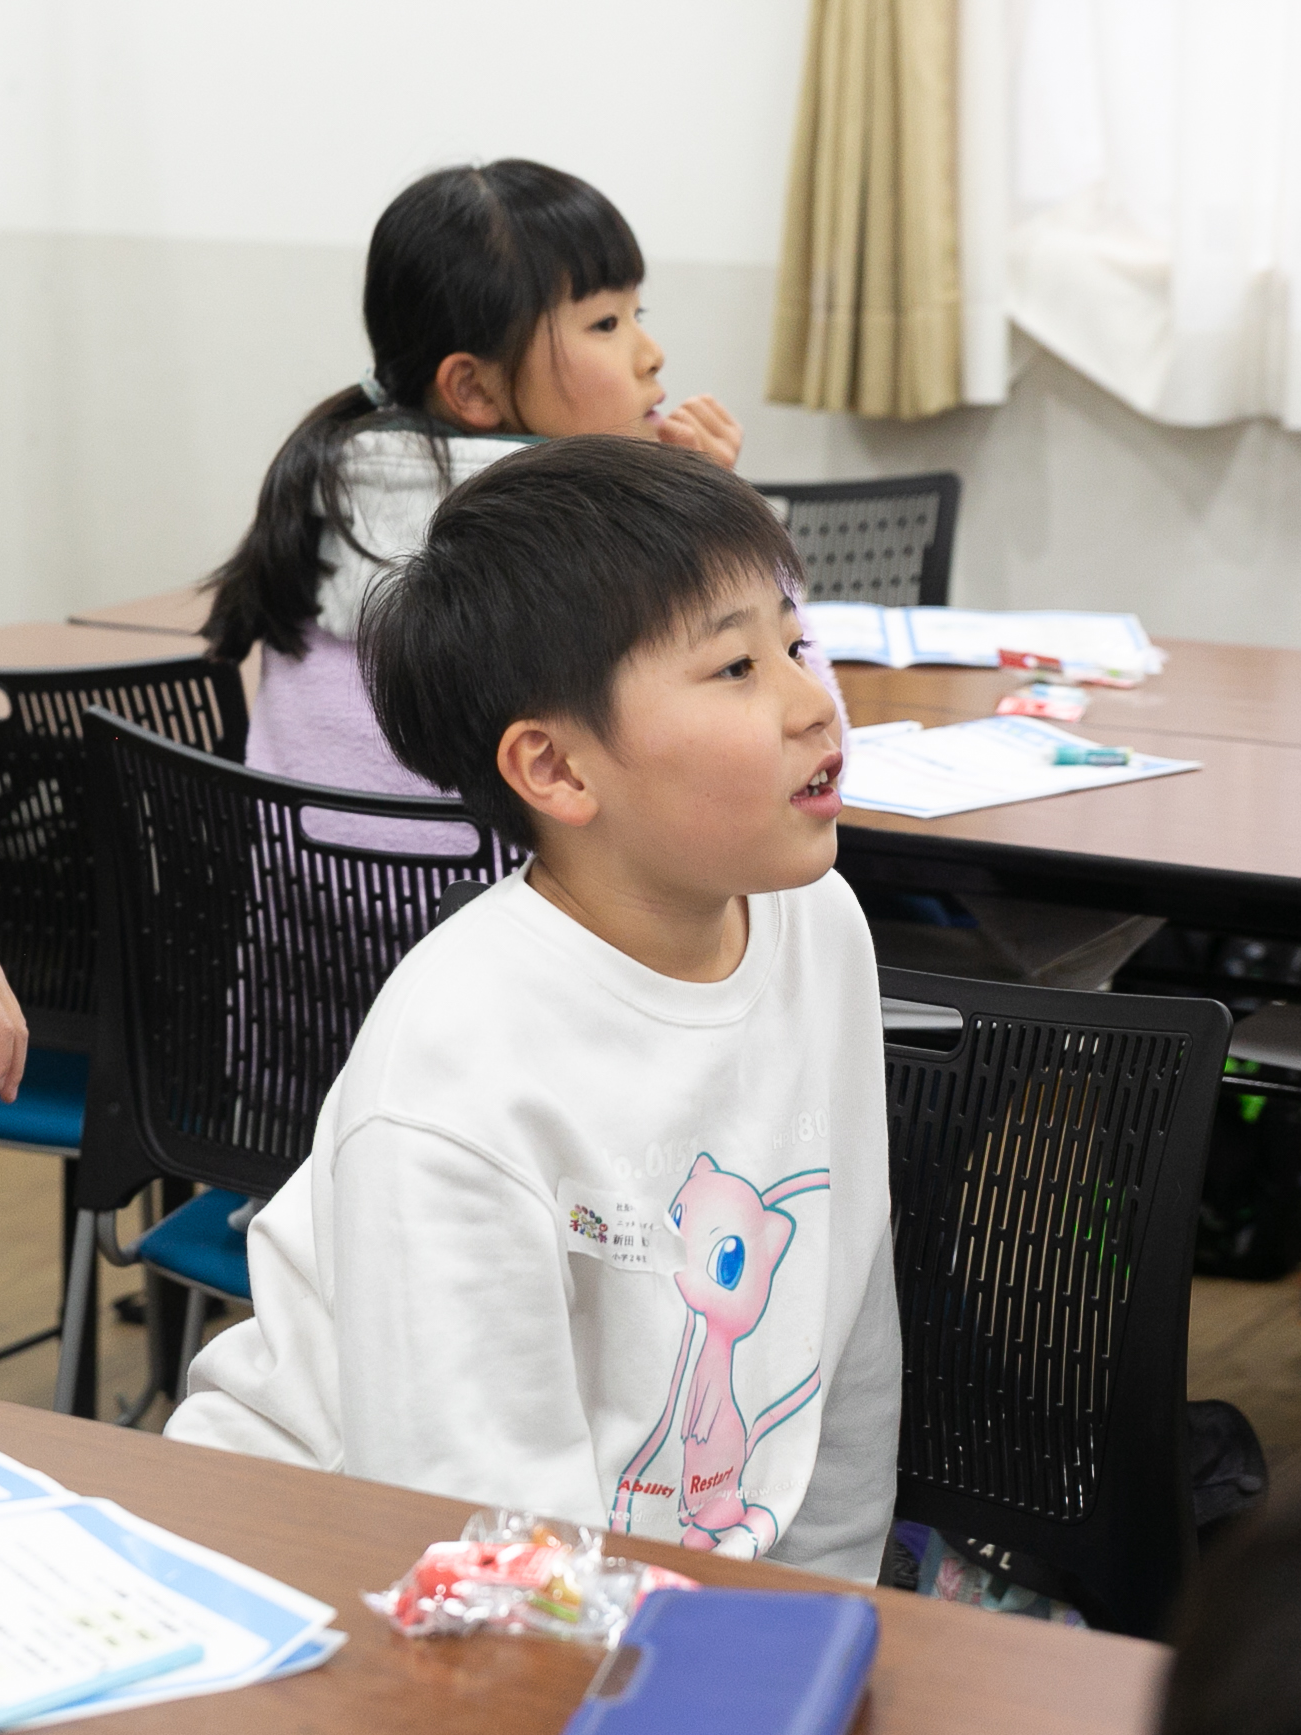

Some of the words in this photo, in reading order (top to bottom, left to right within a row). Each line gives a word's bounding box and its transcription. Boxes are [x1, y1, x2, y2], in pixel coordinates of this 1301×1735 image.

[617, 1479, 676, 1499] Ability
[690, 1466, 734, 1495] Restart
[734, 1485, 771, 1500] draw
